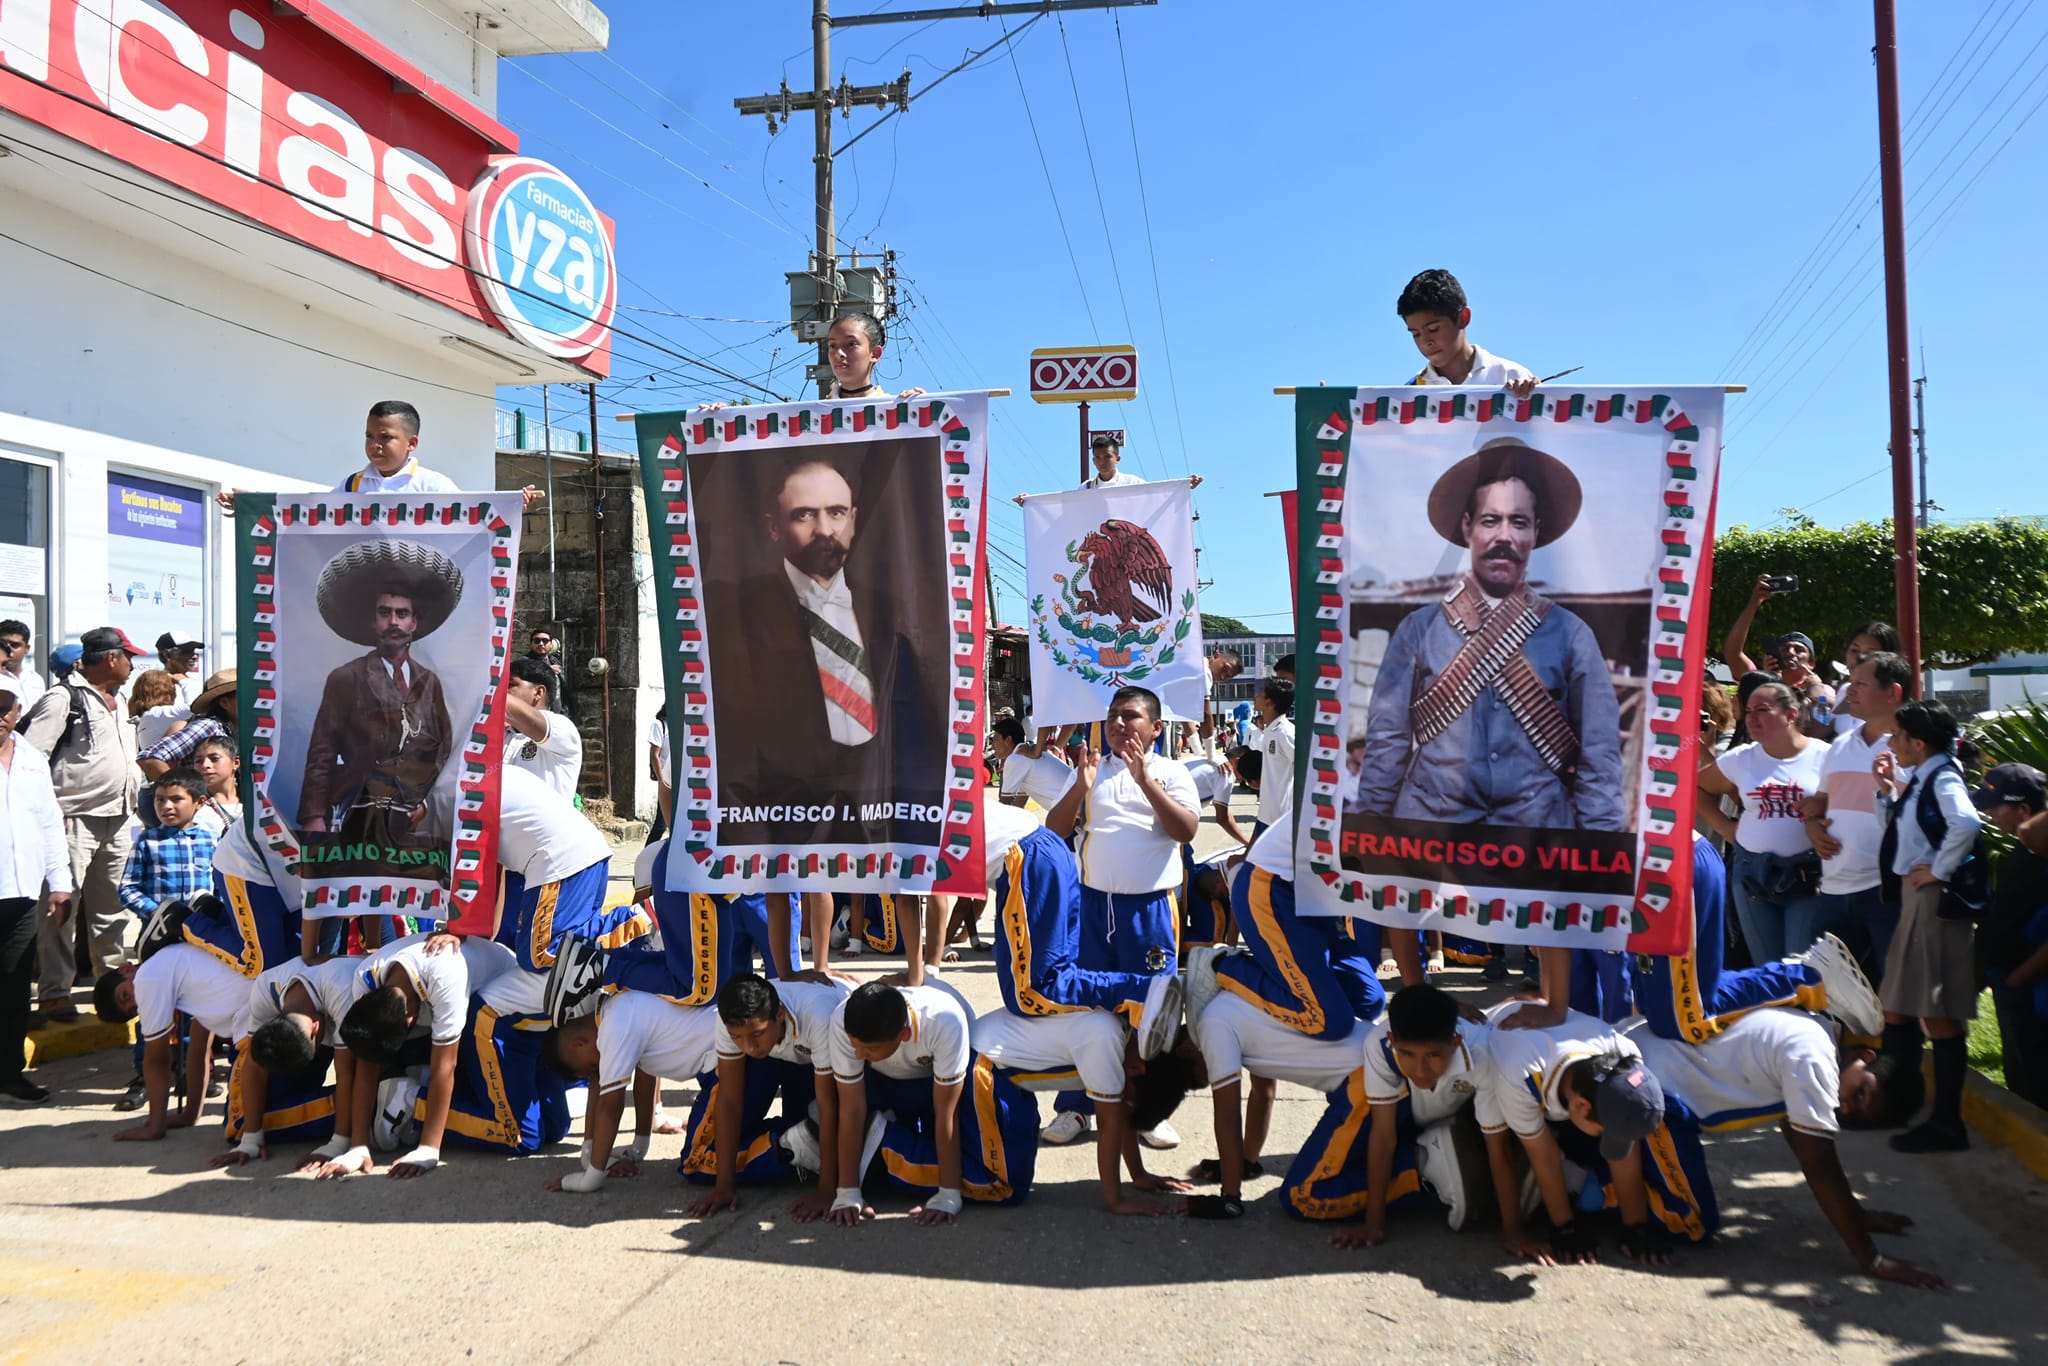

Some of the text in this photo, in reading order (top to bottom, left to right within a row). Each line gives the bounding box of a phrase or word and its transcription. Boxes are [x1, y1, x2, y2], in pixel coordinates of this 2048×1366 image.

[1034, 357, 1132, 390] OXXO
[717, 802, 944, 823] FRANCISCO I. MADERO
[301, 842, 380, 863] LIANO
[1342, 831, 1633, 874] FRANCISCO VILLA
